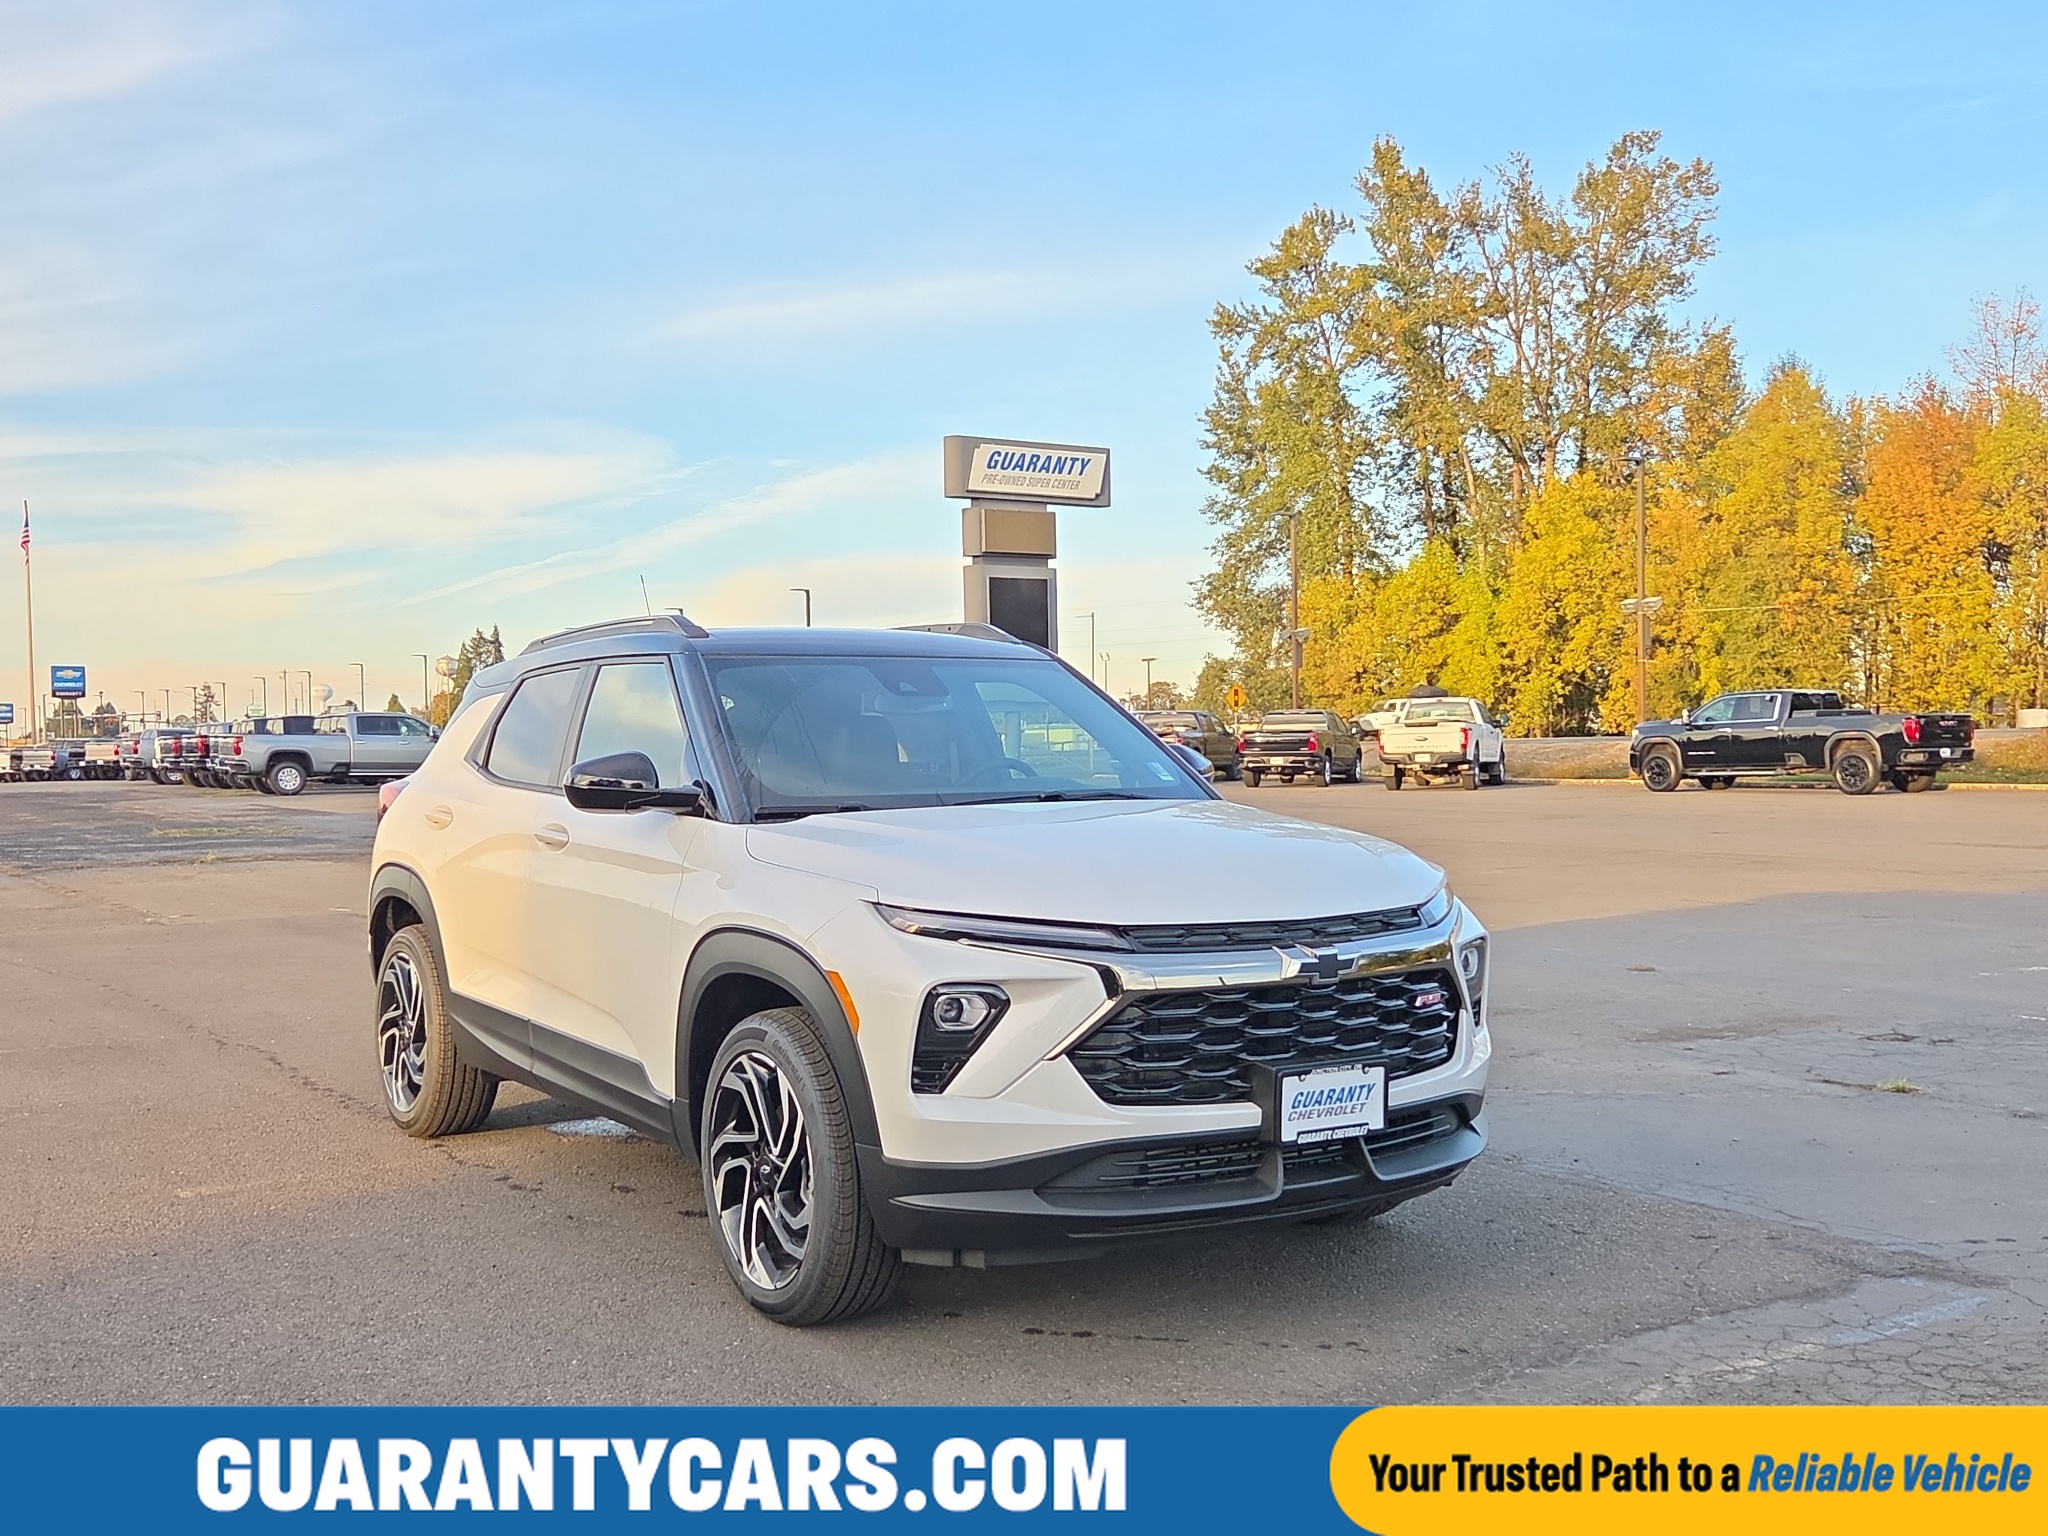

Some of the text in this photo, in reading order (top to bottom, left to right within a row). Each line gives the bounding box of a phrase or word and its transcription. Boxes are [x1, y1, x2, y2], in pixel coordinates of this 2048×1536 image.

[986, 450, 1092, 476] GUARANTY
[981, 473, 1081, 490] PRE-OWNED SUPER CENTER
[1291, 1083, 1376, 1110] GUARANTY
[1288, 1102, 1367, 1122] CHEVROLET
[1333, 1125, 1369, 1139] CHEVROLET
